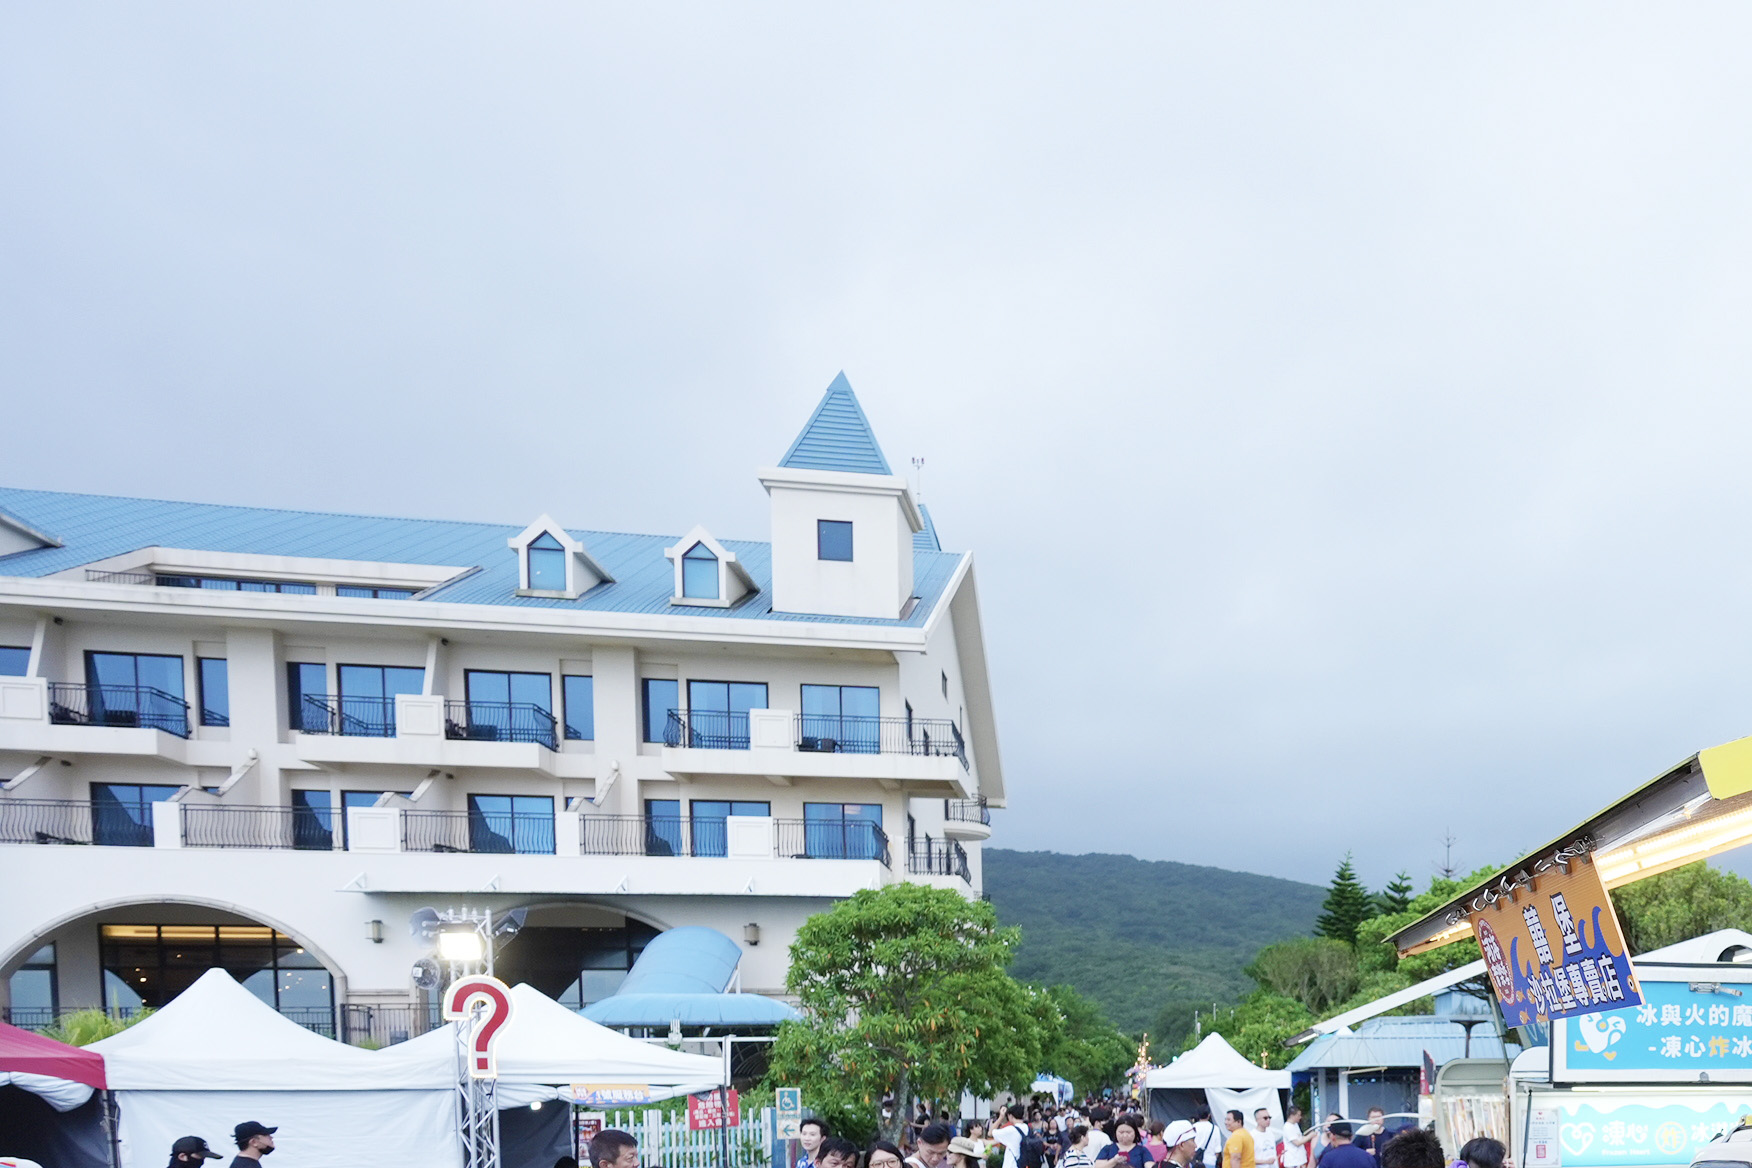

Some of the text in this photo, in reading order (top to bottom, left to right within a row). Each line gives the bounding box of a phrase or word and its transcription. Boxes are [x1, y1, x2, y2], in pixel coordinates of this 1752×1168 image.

[1527, 953, 1625, 1015] 沙拉堡專賣店
